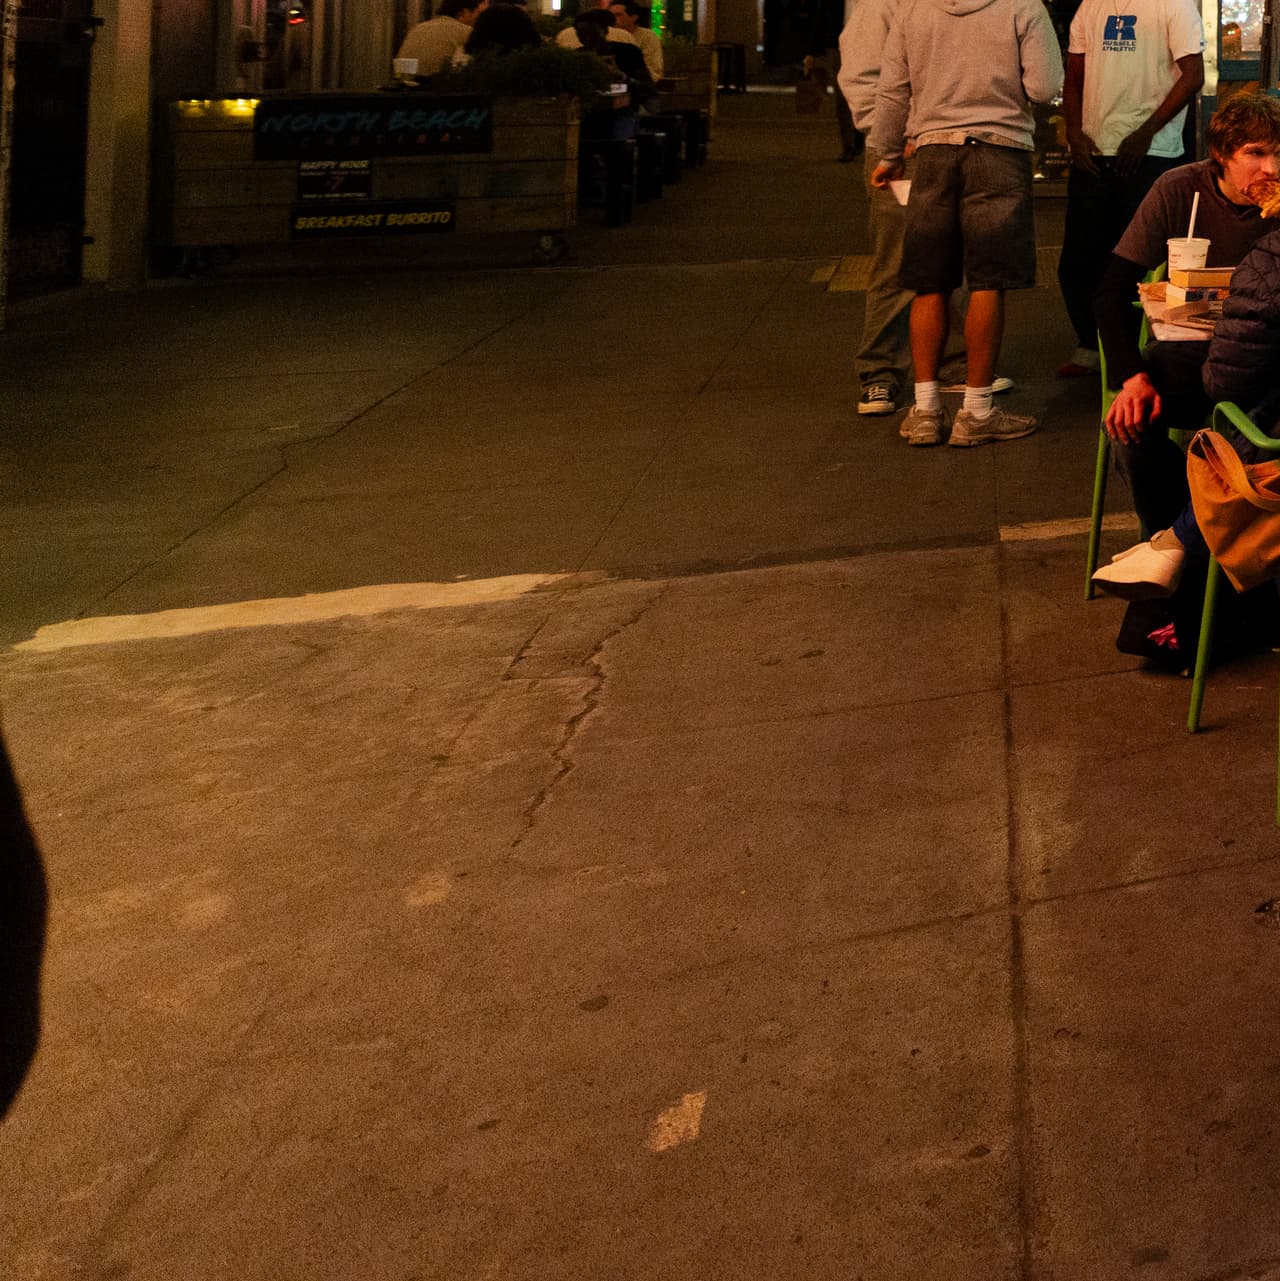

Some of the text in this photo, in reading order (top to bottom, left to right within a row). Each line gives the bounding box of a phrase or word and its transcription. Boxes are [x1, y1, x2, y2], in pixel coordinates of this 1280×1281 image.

[259, 107, 488, 134] NORTH BEACH
[294, 211, 451, 230] BREAKFAST BURRITO
